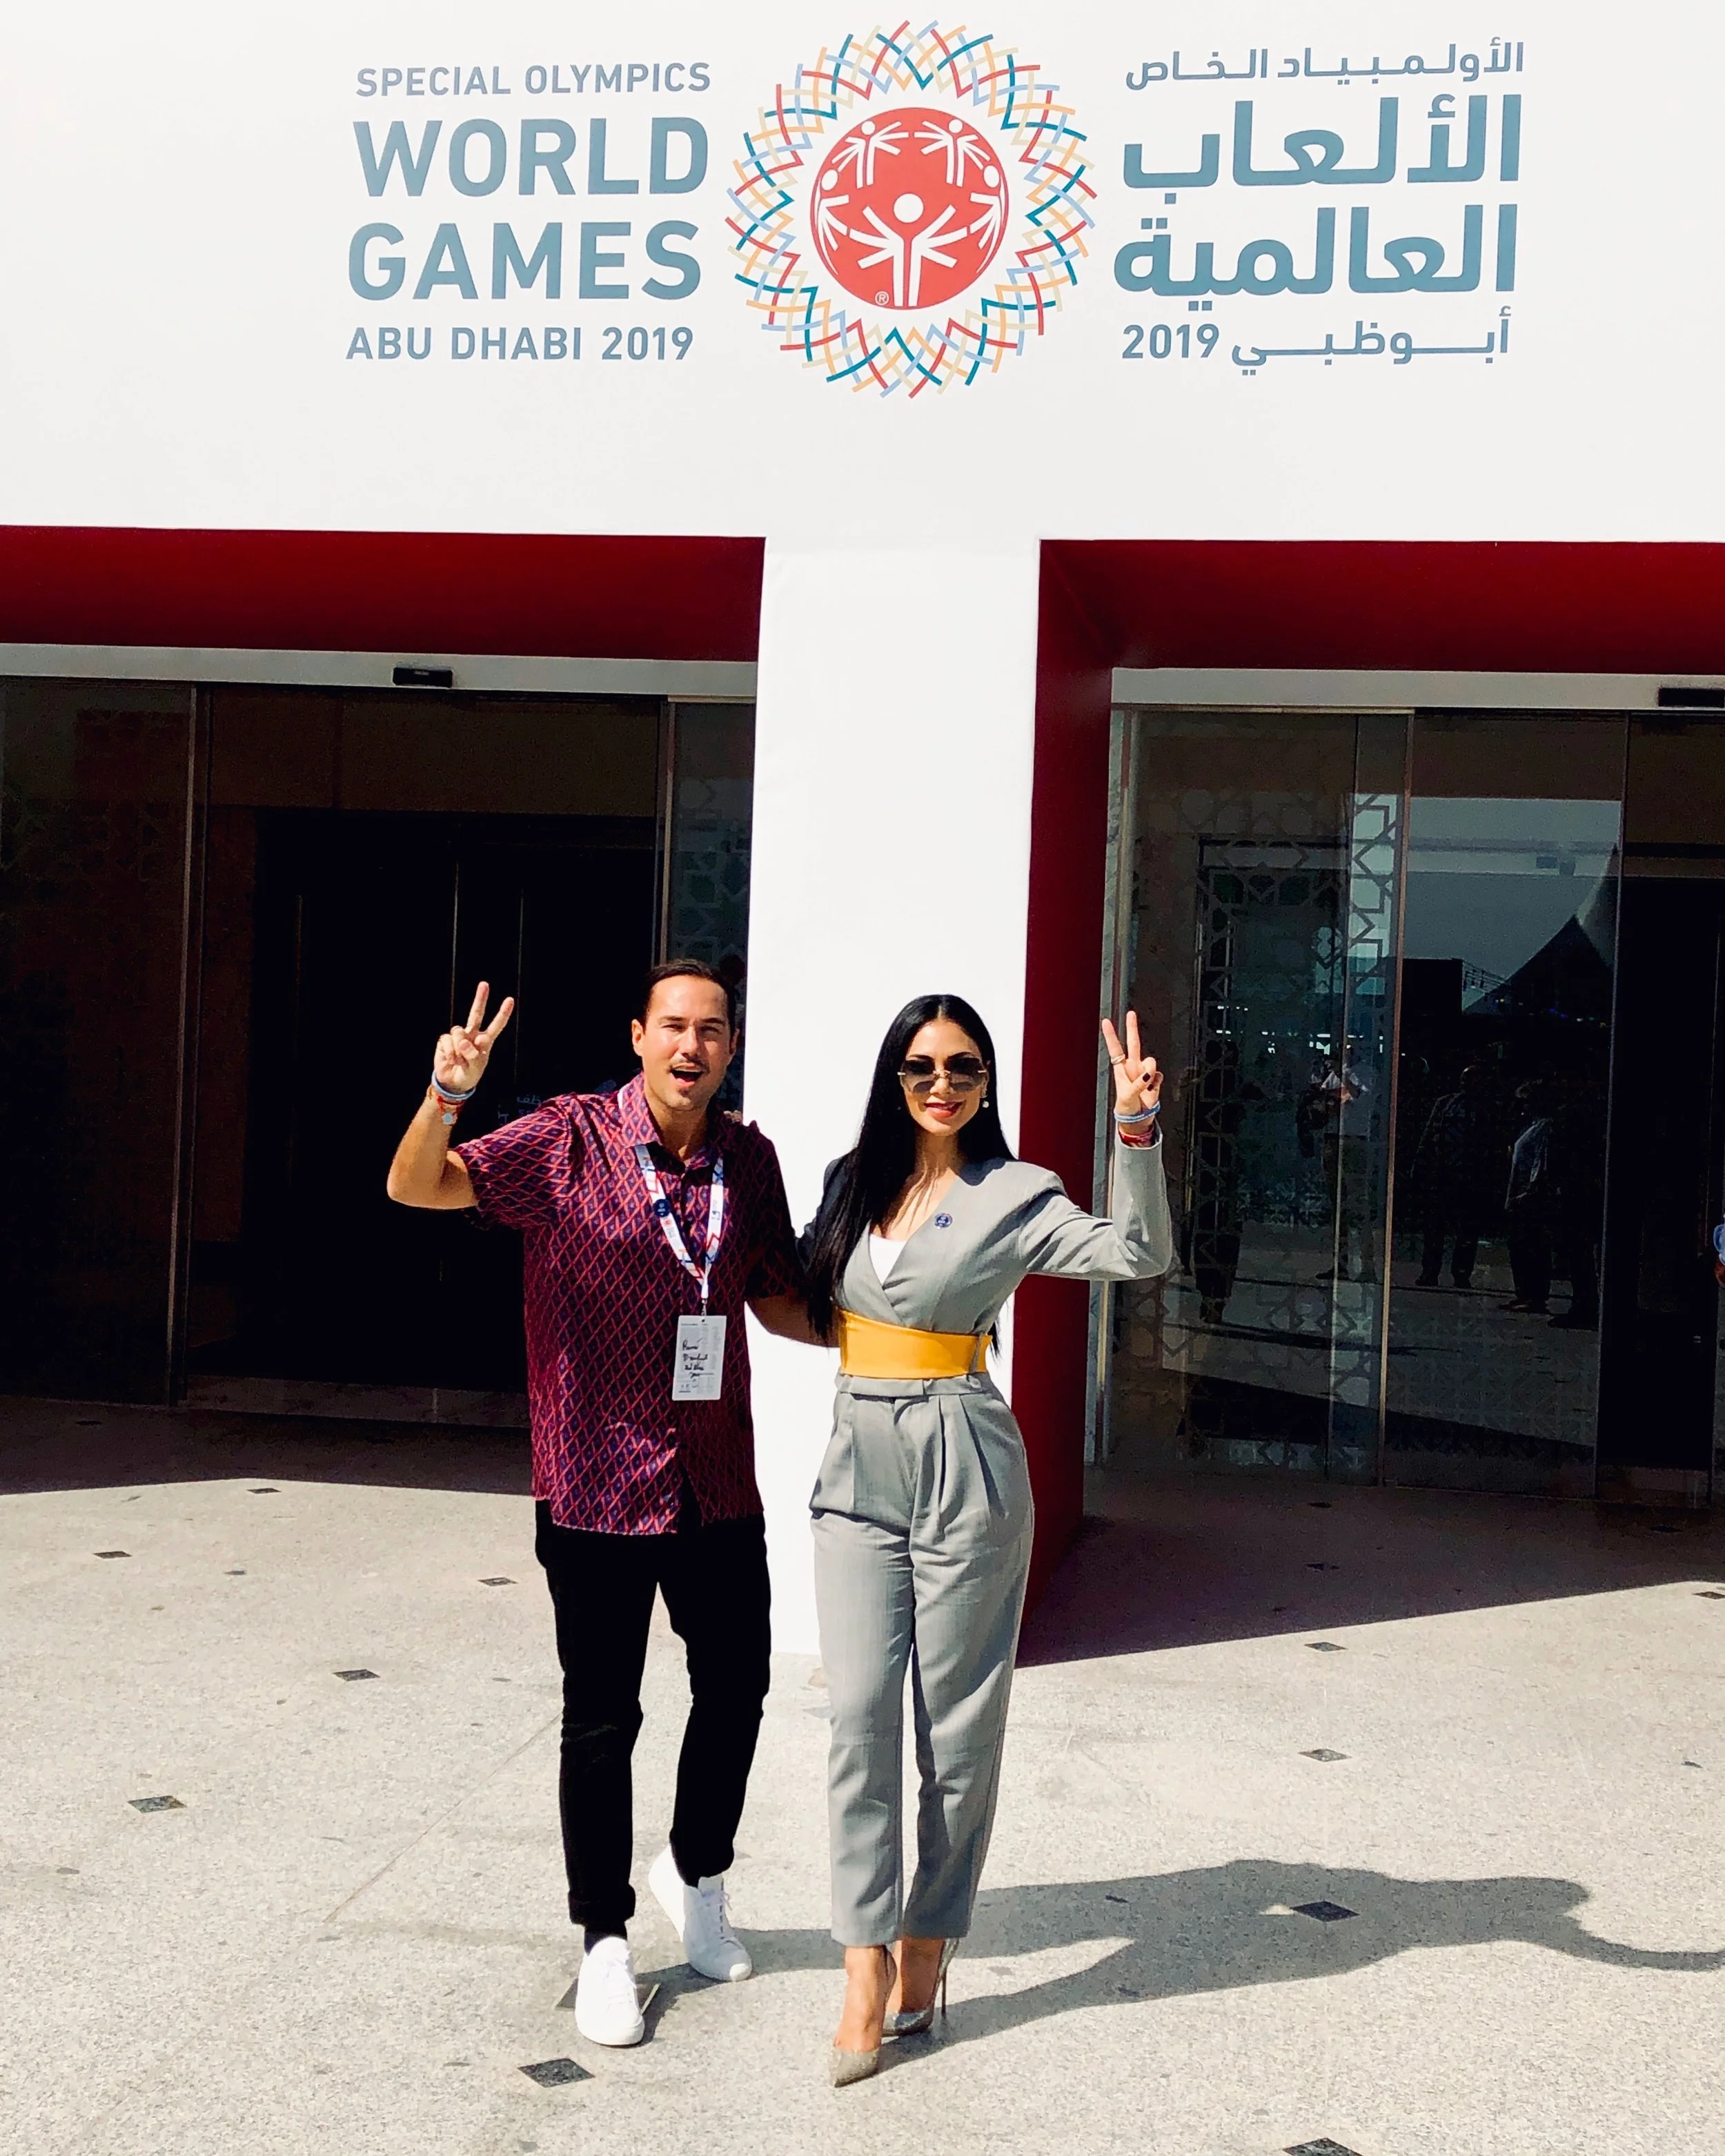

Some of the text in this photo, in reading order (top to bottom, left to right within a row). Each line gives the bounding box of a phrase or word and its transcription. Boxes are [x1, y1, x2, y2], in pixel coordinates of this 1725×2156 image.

[356, 62, 711, 97] SPECIAL OLYMPICS
[1125, 36, 1524, 91] الأولمبياد الخاص
[353, 117, 709, 197] WORLD
[1123, 93, 1522, 205] الألعاب
[348, 219, 701, 301] GAMES
[1113, 204, 1518, 312] العالمية
[345, 326, 693, 360] ABU DHABI 2019
[1121, 305, 1512, 376] أبوظبي 2019
